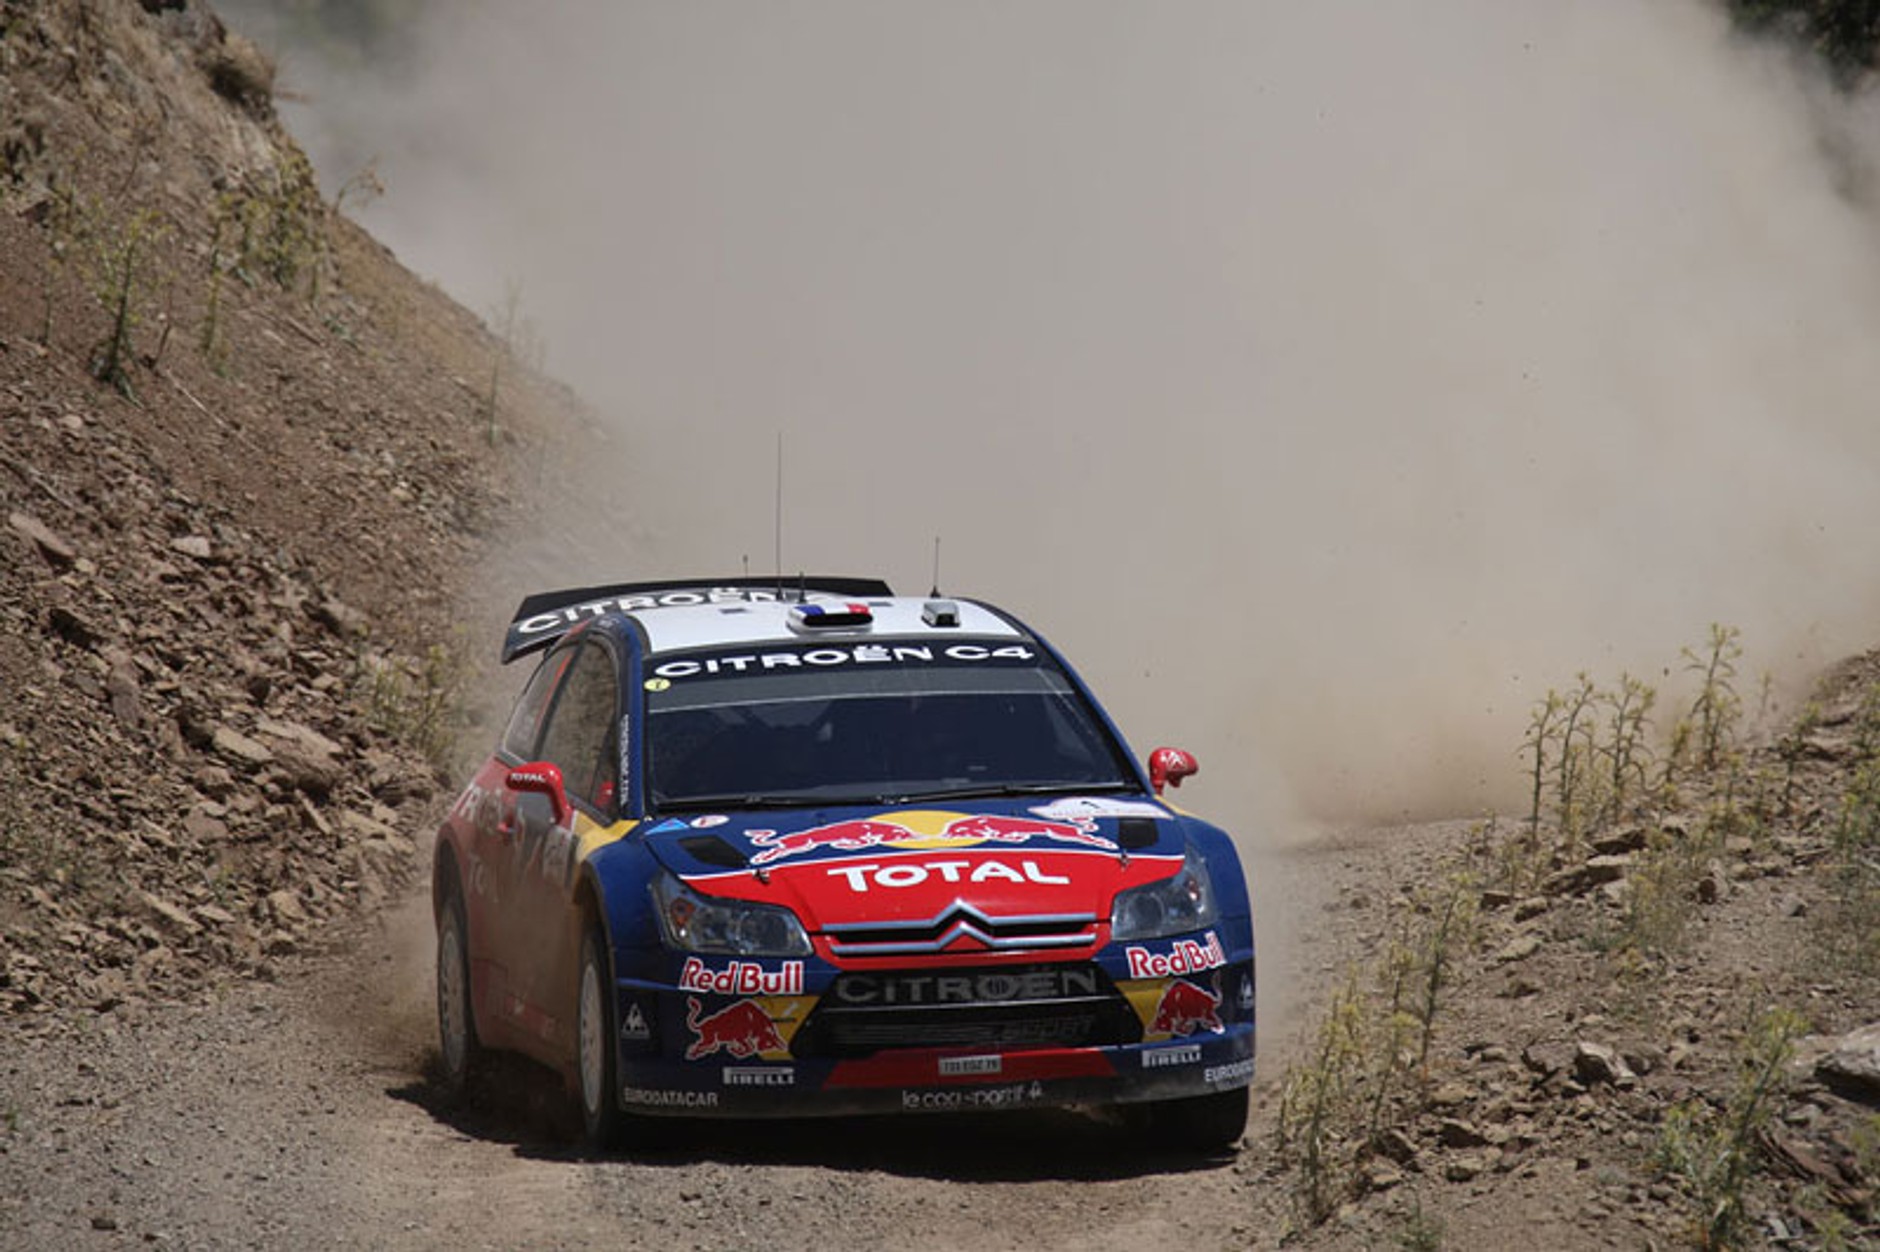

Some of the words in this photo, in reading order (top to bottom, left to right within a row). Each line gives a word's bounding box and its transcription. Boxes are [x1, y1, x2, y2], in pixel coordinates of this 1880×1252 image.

[655, 645, 934, 677] CITROËN
[944, 645, 1035, 661] C4
[510, 773, 546, 783] TOTAL
[827, 861, 1070, 892] TOTAL
[678, 957, 739, 994] Red
[738, 960, 804, 994] Bull
[1125, 942, 1187, 978] Red
[1142, 1045, 1201, 1068] PIRELLI
[723, 1066, 795, 1085] PIRELLI
